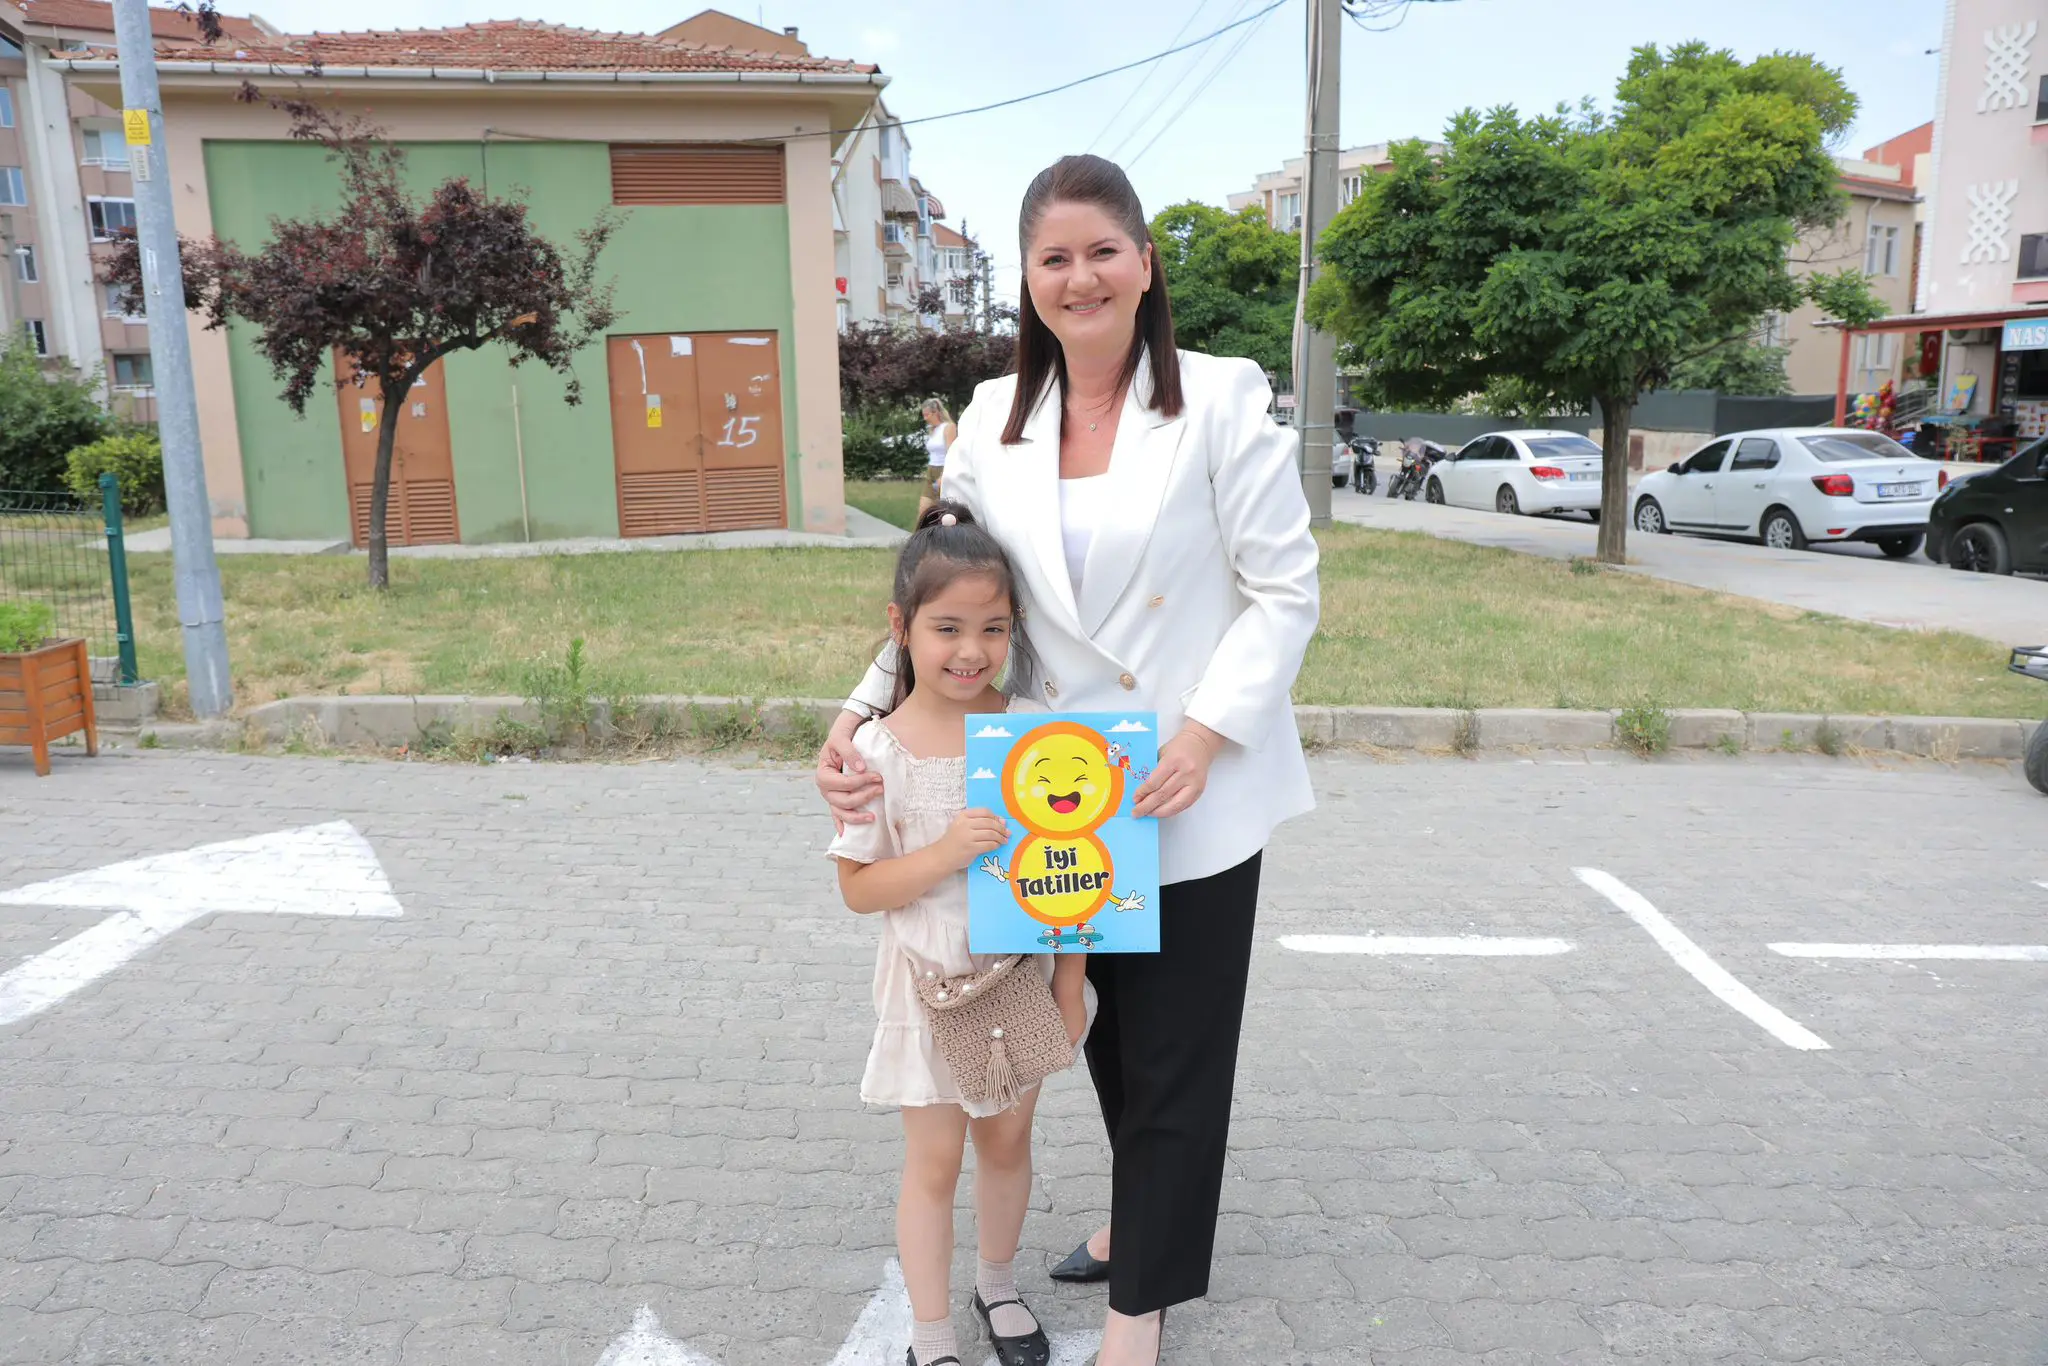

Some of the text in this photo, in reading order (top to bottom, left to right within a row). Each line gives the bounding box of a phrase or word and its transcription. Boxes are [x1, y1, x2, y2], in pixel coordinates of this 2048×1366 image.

[717, 416, 761, 448] 15
[1044, 845, 1077, 870] İyi
[1016, 871, 1110, 898] Tatiller
